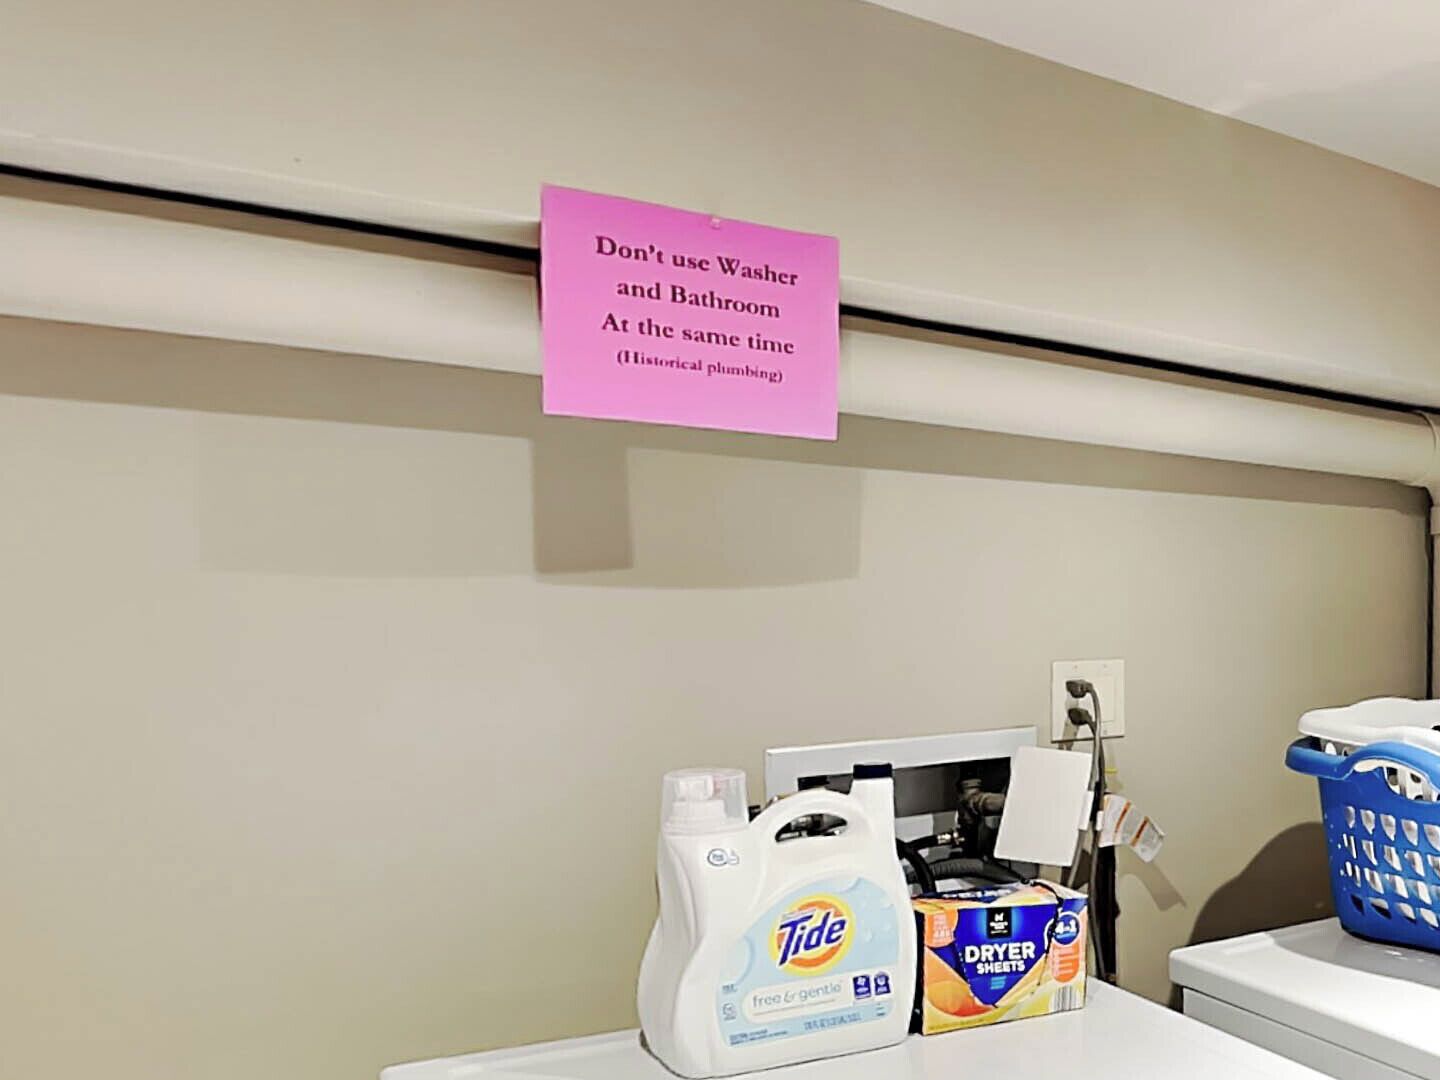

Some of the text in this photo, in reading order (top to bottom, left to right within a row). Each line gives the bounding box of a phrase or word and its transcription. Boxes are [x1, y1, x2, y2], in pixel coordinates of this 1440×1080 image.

[595, 235, 798, 286] Don't use Washer
[617, 282, 780, 318] and Bathroom
[602, 312, 795, 354] At the same time
[617, 350, 783, 383] (Historical plumbing)
[777, 911, 846, 966] Tide
[965, 941, 1036, 963] DRYER
[977, 960, 1025, 975] SHEETS
[752, 992, 782, 1009] free
[799, 981, 842, 1002] gentle
